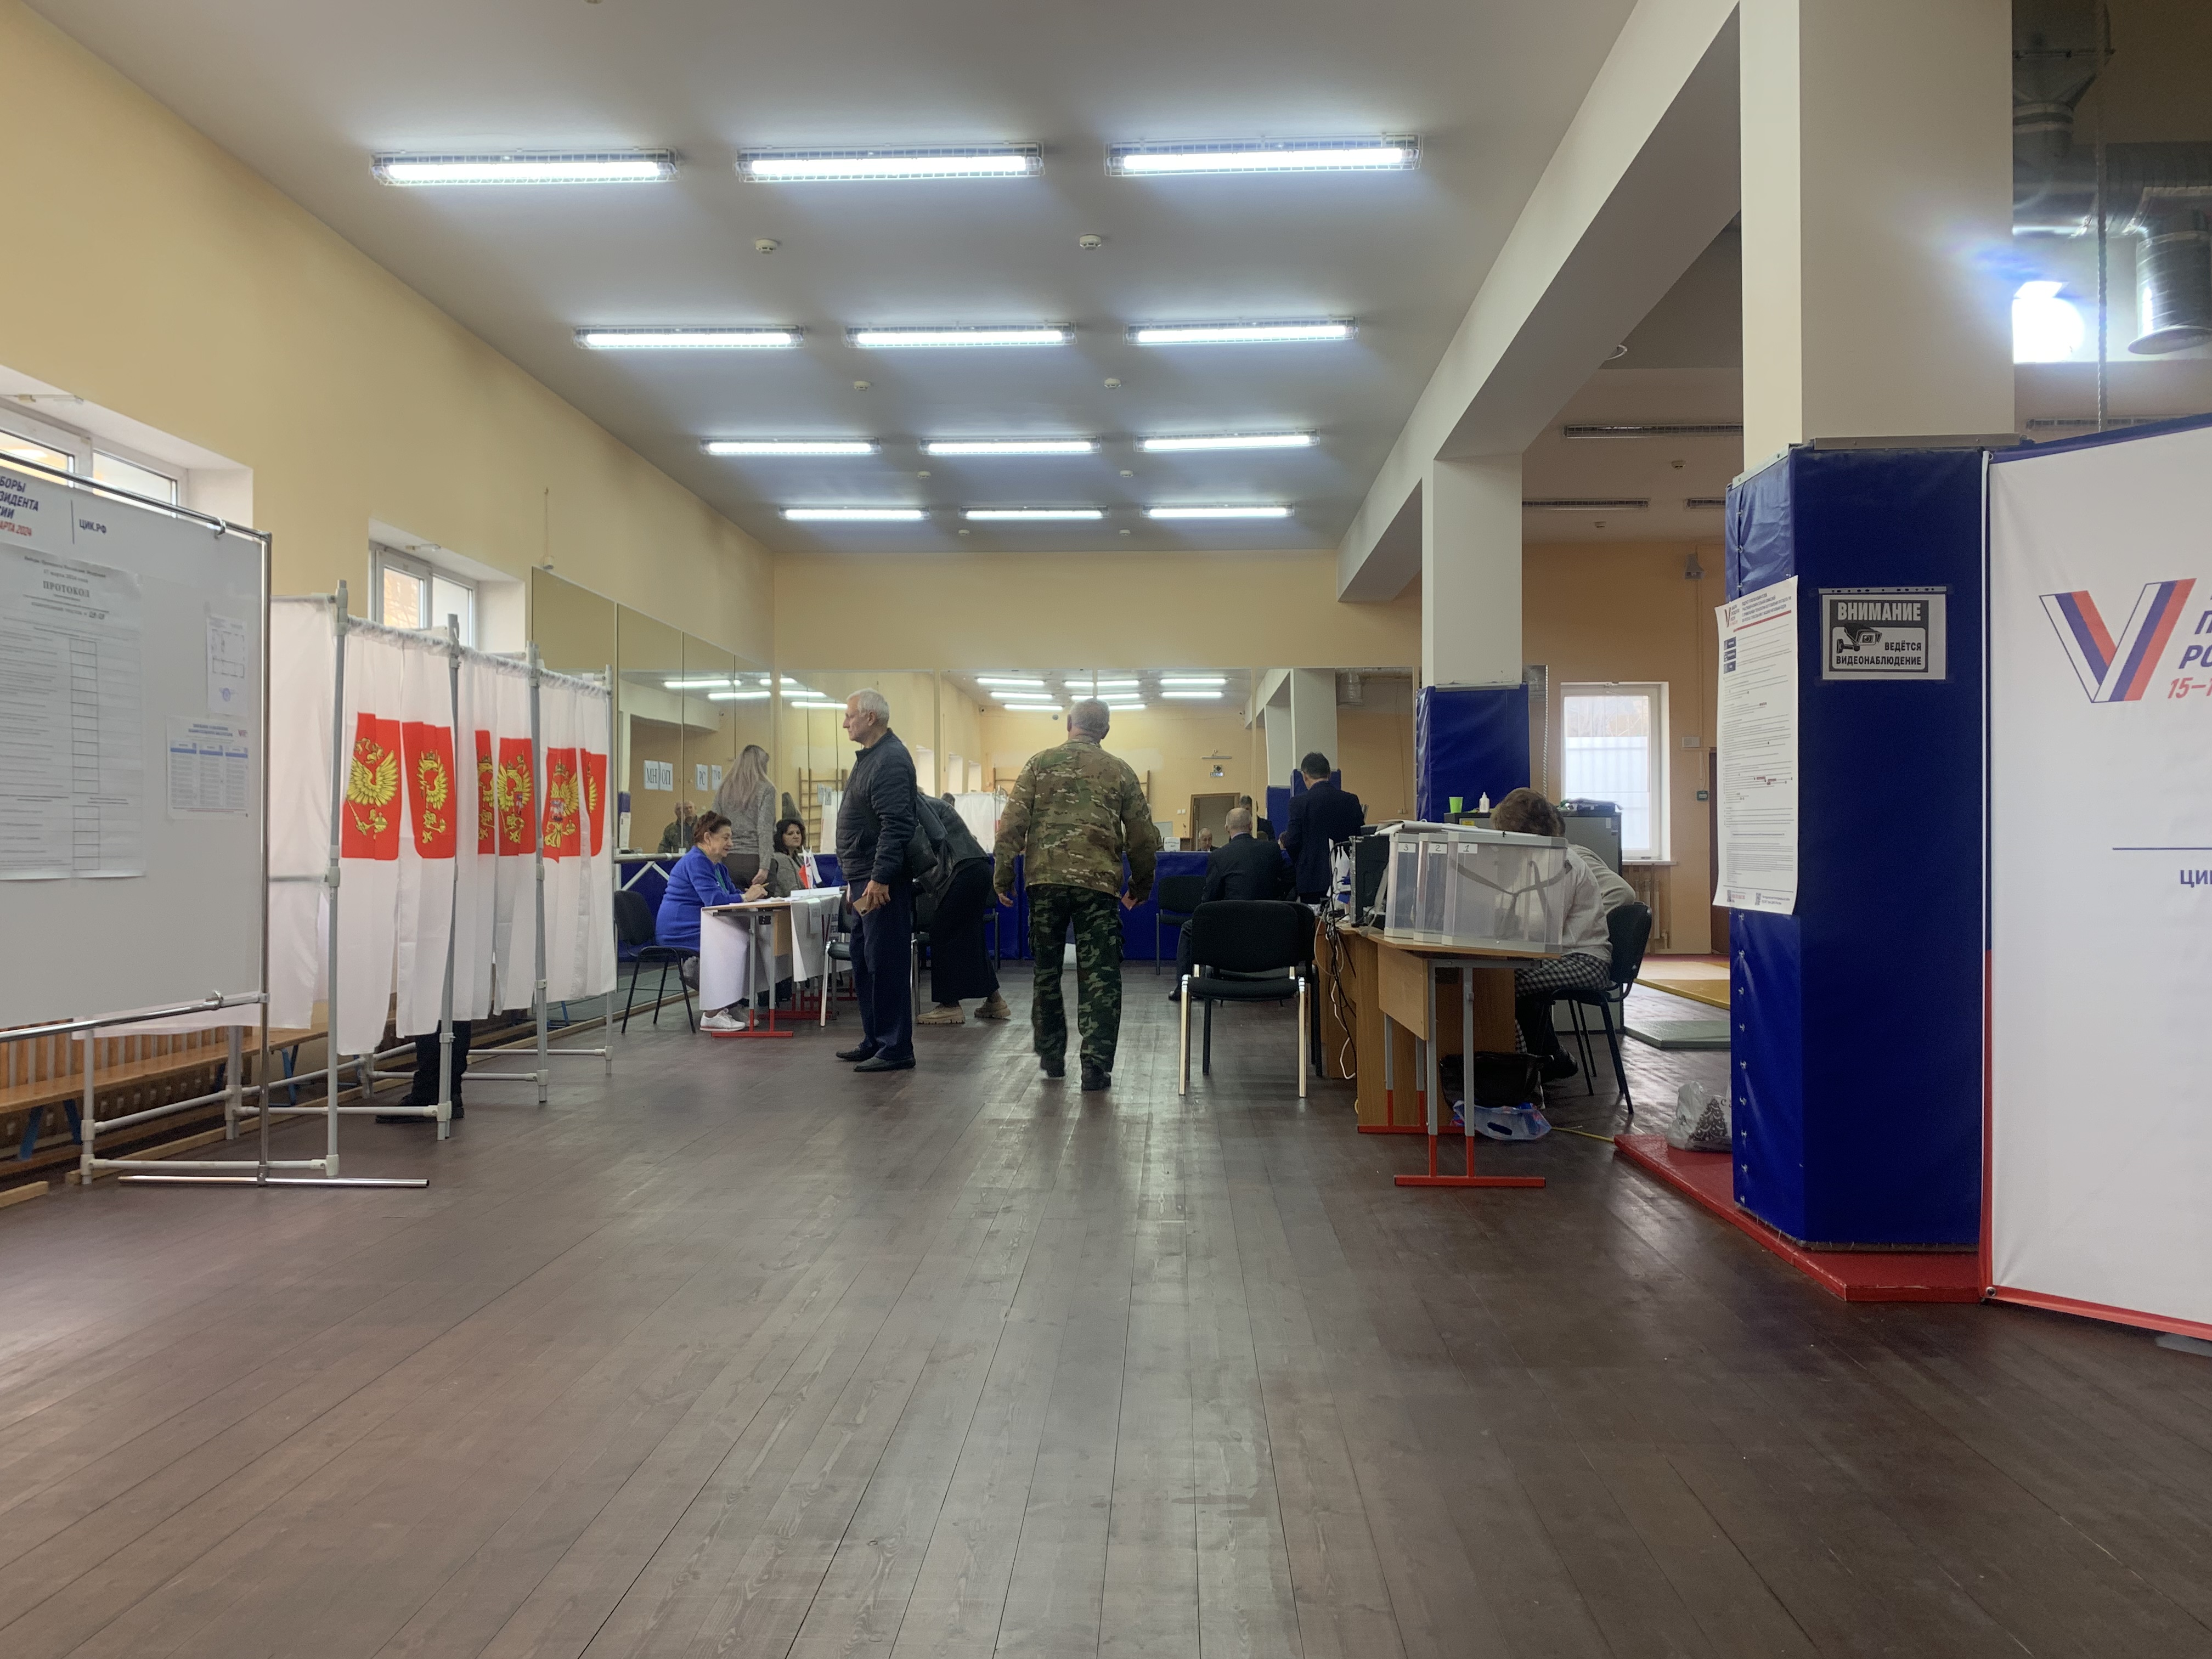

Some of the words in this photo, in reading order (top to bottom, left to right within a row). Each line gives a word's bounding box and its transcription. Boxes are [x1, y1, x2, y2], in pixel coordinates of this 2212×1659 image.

[0, 476, 26, 493] БОРЫ
[80, 519, 107, 534] ЦИК.РФ
[43, 580, 90, 598] ПРОТОКОЛ
[1837, 602, 1921, 622] ВНИМАНИЕ
[1884, 640, 1921, 652] ВЕДЁТСЯ
[1836, 656, 1922, 667] ВИДЕОНАБЛЮДЕНИЕ
[646, 768, 657, 784] МН
[662, 769, 671, 786] ОП
[699, 770, 706, 786] РС
[2180, 870, 2212, 888] ЦИ
